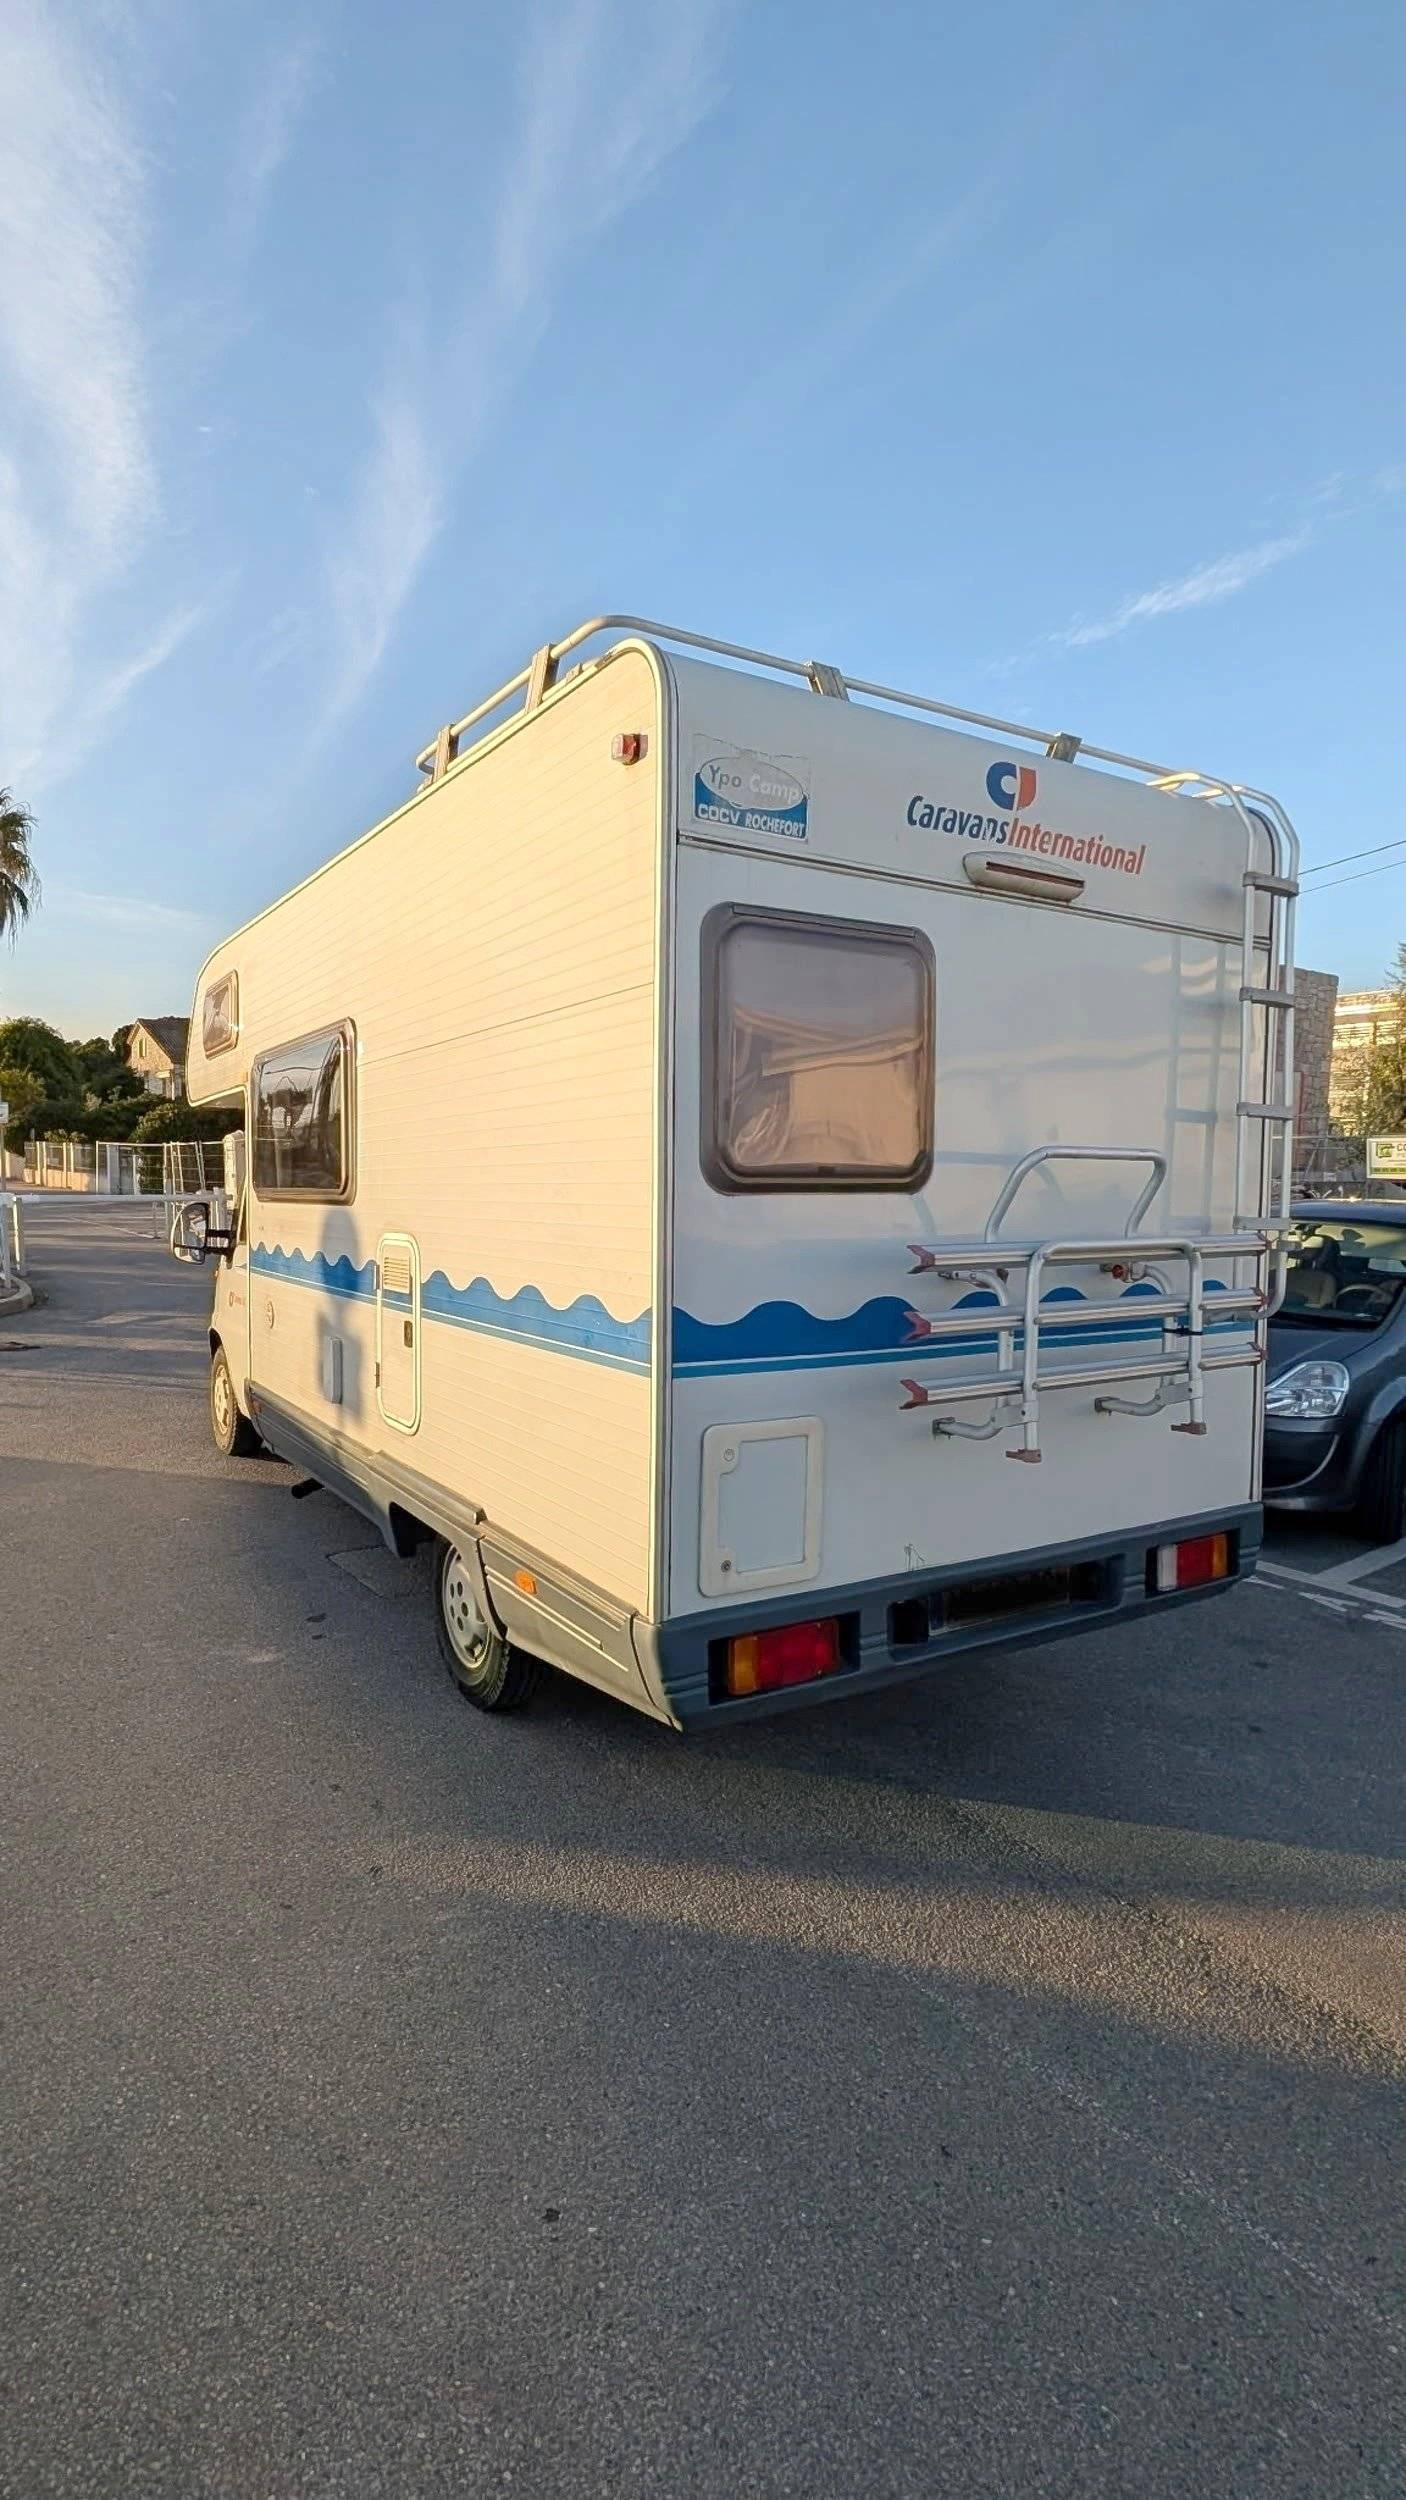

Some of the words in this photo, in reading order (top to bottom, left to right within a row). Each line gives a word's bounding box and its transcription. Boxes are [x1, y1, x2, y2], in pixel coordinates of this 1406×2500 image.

[709, 764, 742, 790] Ypo
[749, 773, 799, 804] Camp
[745, 812, 805, 837] ROCHEFORT
